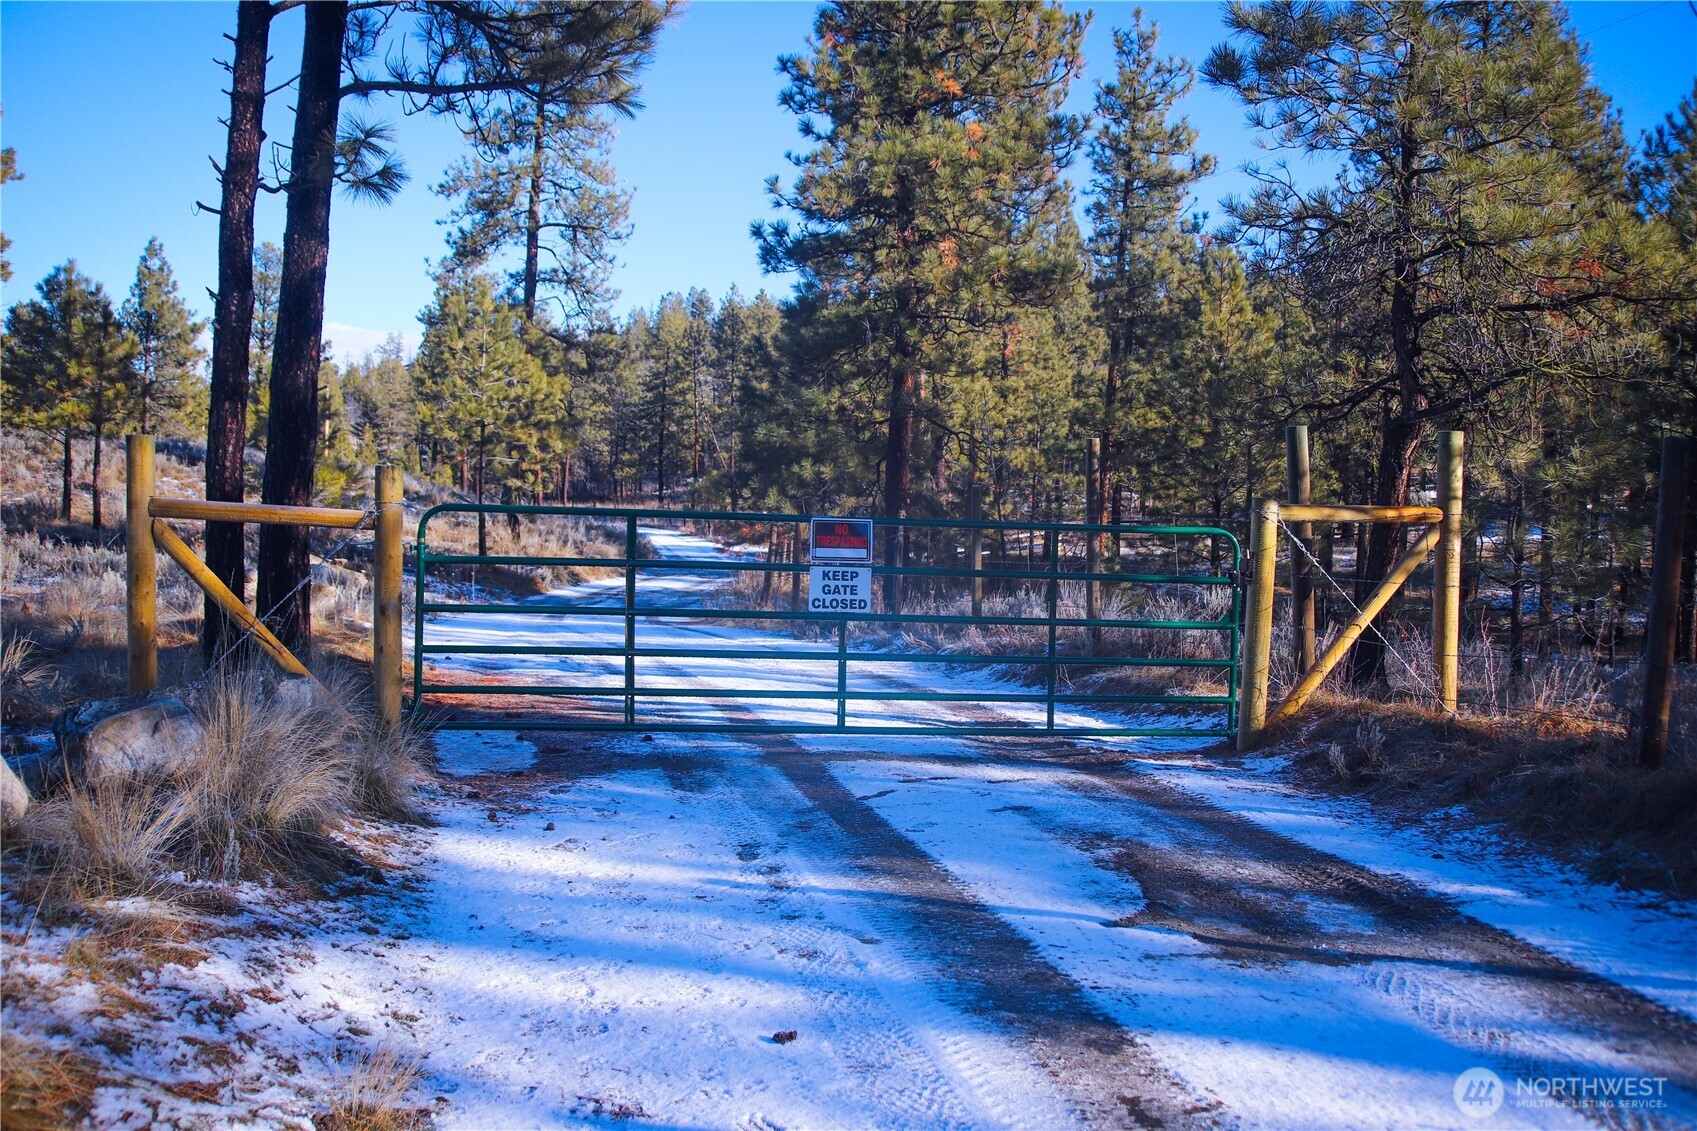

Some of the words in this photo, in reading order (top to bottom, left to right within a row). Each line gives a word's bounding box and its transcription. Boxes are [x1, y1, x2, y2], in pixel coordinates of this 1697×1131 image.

[835, 524, 849, 535] NO
[816, 536, 867, 548] TRESPASSING
[822, 570, 859, 581] KEEP
[821, 584, 858, 595] GATE
[811, 598, 868, 610] CLOSED
